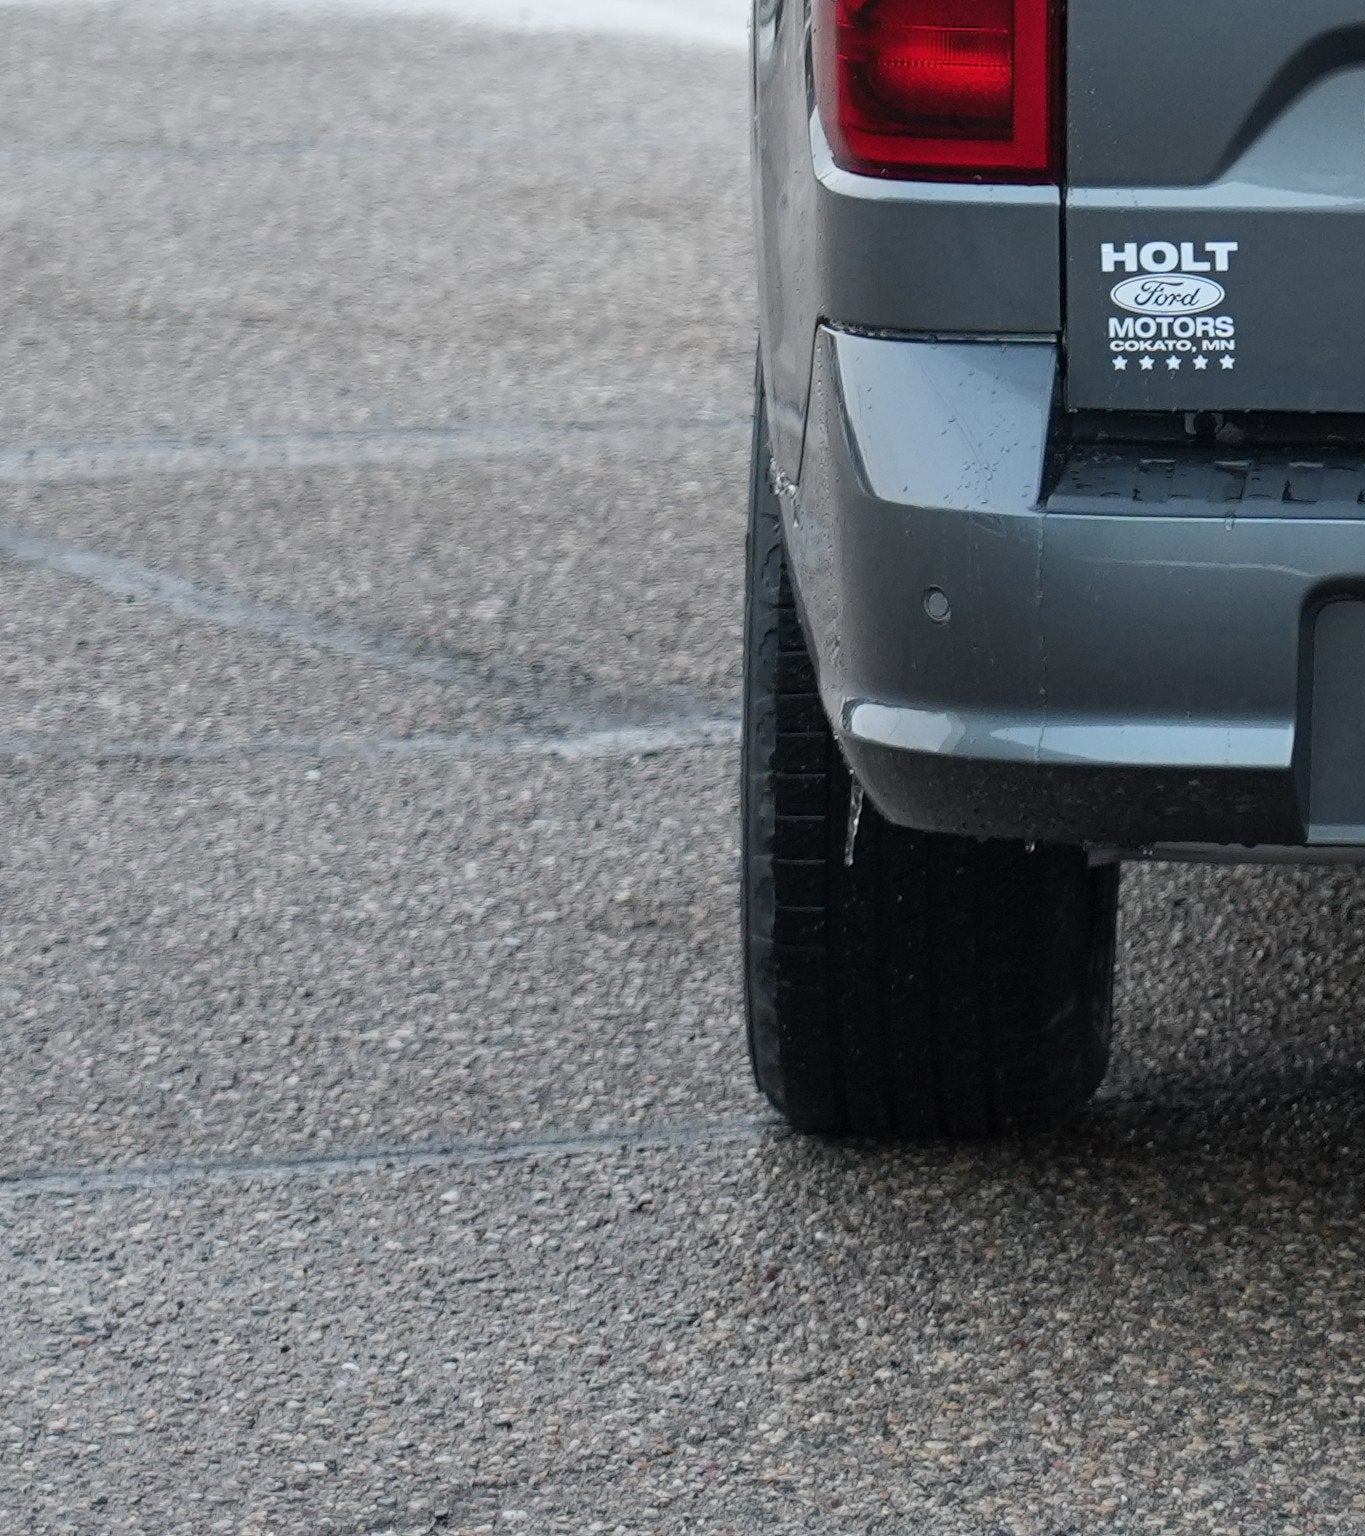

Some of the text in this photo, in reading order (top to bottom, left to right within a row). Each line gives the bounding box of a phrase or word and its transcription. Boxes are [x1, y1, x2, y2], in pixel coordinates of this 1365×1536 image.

[1101, 241, 1238, 273] HOLT
[1134, 280, 1201, 306] Ford
[1108, 316, 1235, 338] MOTORS
[1109, 339, 1235, 353] COKATO, MN
